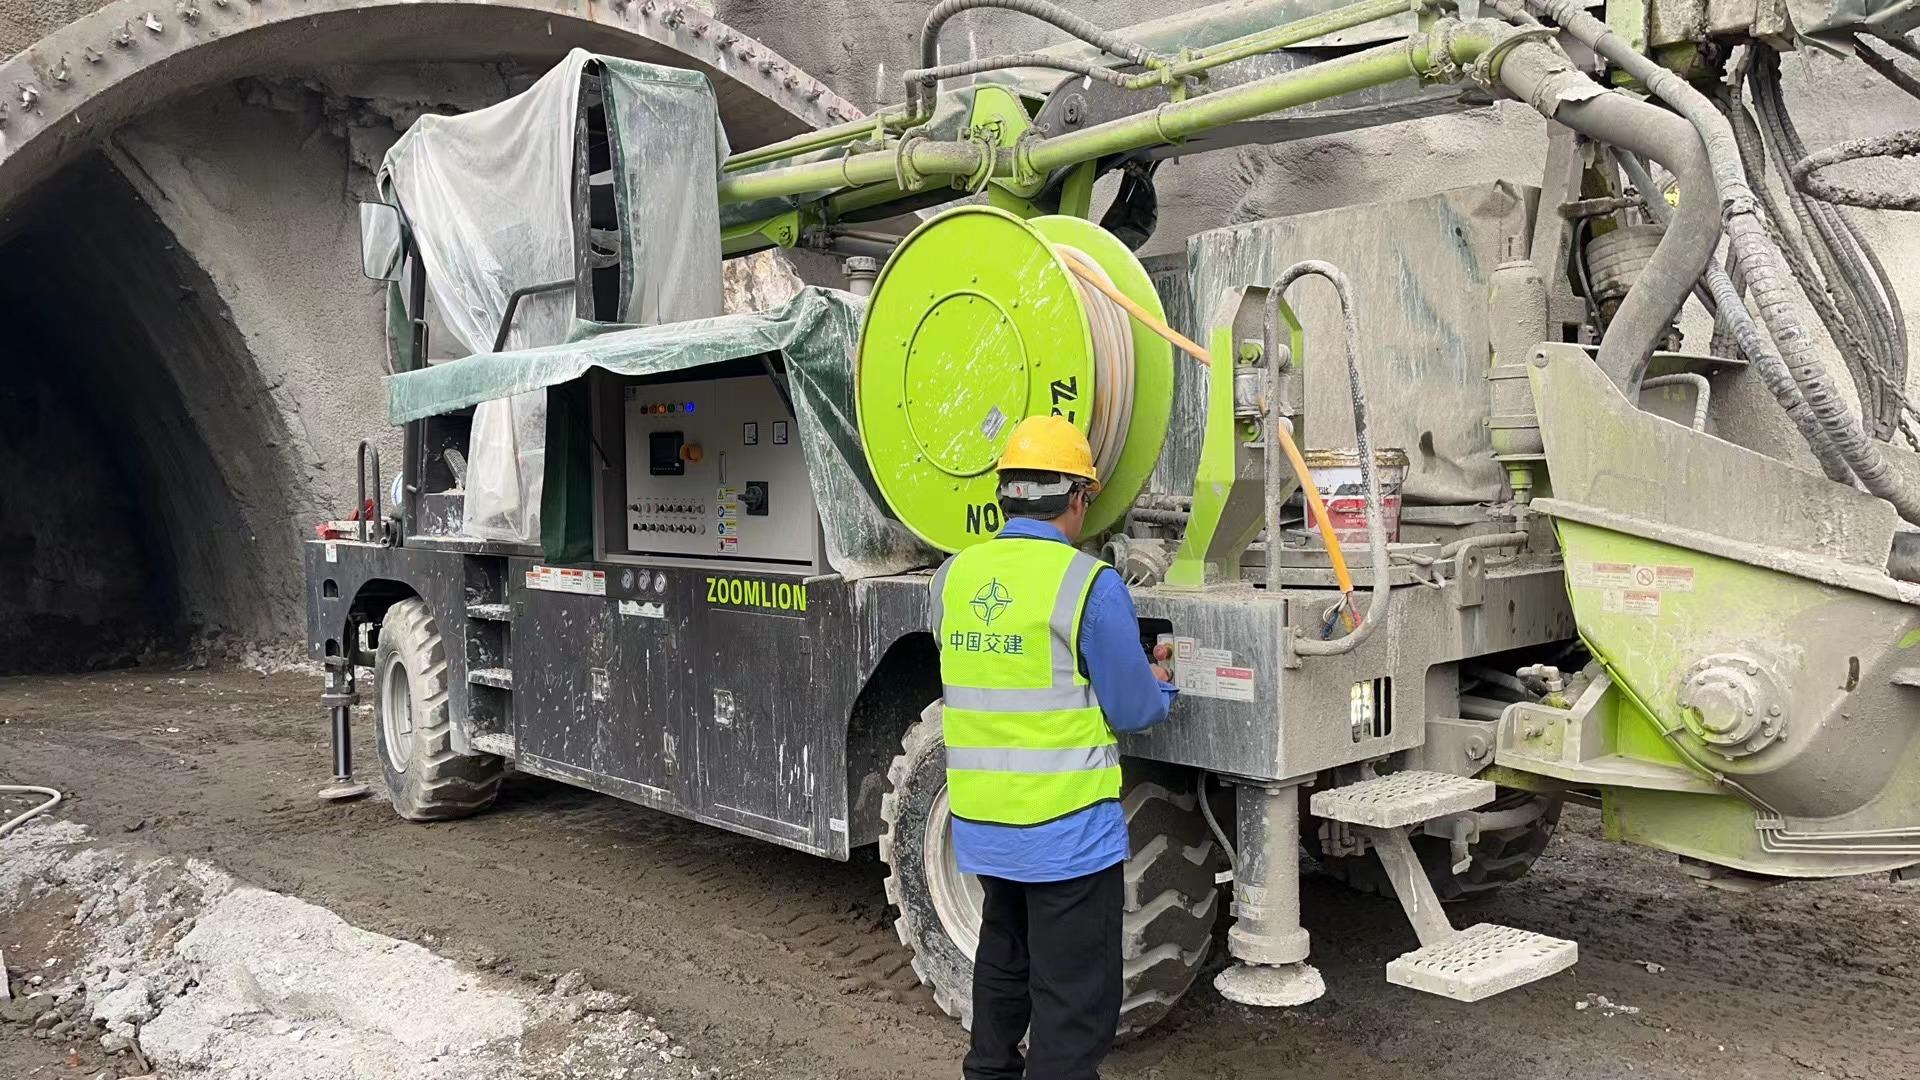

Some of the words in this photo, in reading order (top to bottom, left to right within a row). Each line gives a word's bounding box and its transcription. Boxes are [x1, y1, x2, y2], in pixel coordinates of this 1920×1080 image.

[706, 577, 806, 611] ZOOMLION
[950, 630, 1024, 655] 中国交建
